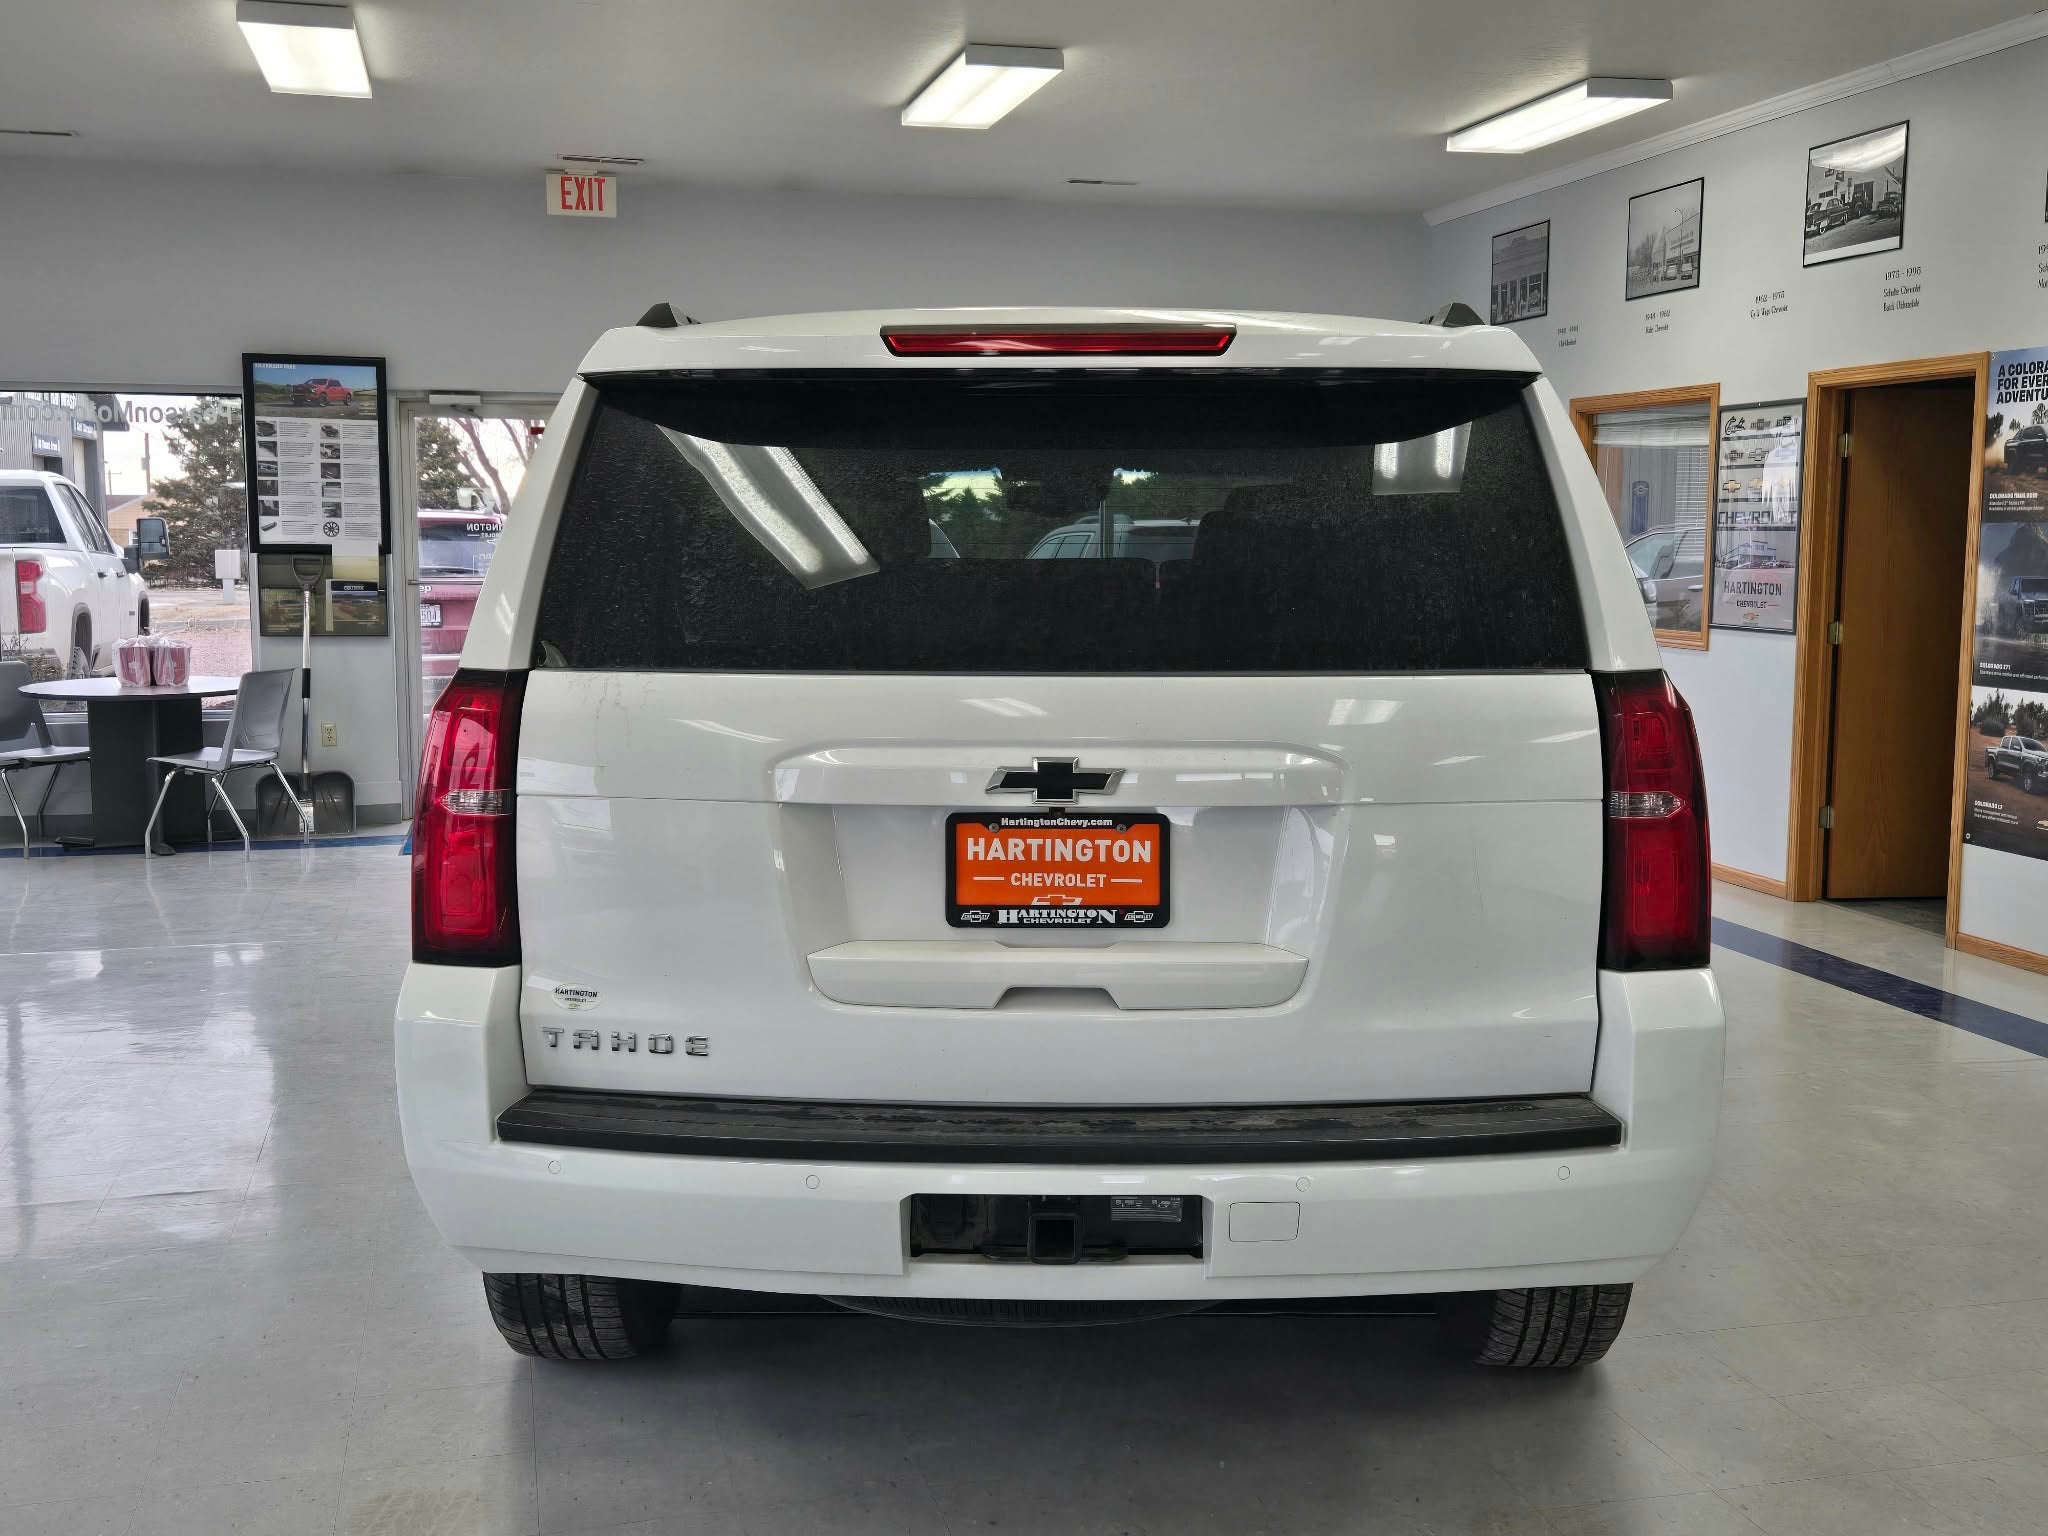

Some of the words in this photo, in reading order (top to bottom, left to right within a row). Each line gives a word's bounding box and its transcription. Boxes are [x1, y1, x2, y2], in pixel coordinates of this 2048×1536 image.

[560, 175, 606, 212] EXIT
[1997, 364, 2006, 378] A
[2008, 360, 2048, 377] COLORA
[1997, 377, 2019, 391] FOR
[2021, 374, 2048, 389] EVER
[1996, 388, 2048, 404] ADVENTU
[1717, 511, 1797, 525] CHEVROT
[1723, 580, 1782, 596] HARTINGTON
[1736, 600, 1767, 609] CHEVROLET
[1001, 817, 1113, 828] HartingtonChevy.com
[967, 837, 1151, 863] HARTINGTON
[1010, 872, 1107, 888] CHEVROLET
[997, 909, 1118, 925] HARTINGTON
[554, 987, 598, 998] HARTINGTON
[541, 1026, 711, 1057] TAHOE
